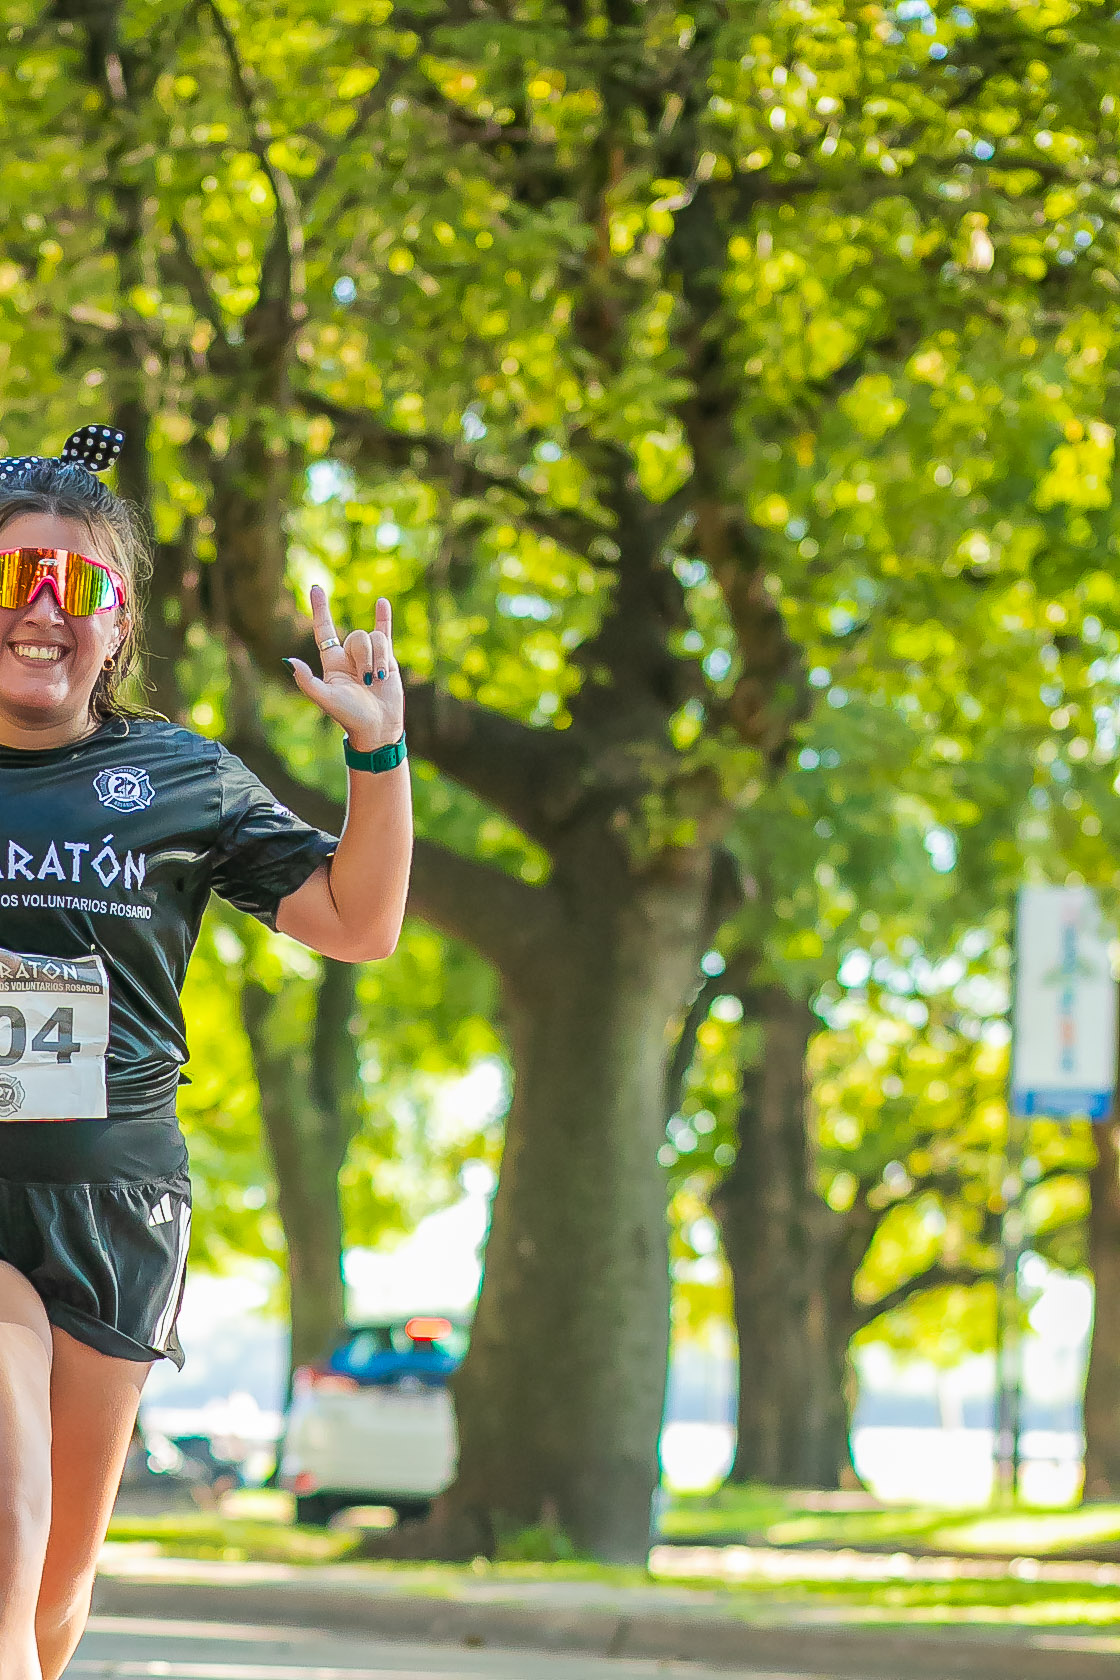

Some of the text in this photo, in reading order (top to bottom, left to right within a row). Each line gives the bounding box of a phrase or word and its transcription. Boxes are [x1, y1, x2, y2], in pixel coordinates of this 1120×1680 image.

[113, 776, 137, 796] 27
[21, 894, 108, 914] VOLUNTARIOS
[109, 902, 152, 920] ROSARIO
[10, 980, 64, 992] VOLUNTARIOS
[65, 982, 100, 993] ROSARIO
